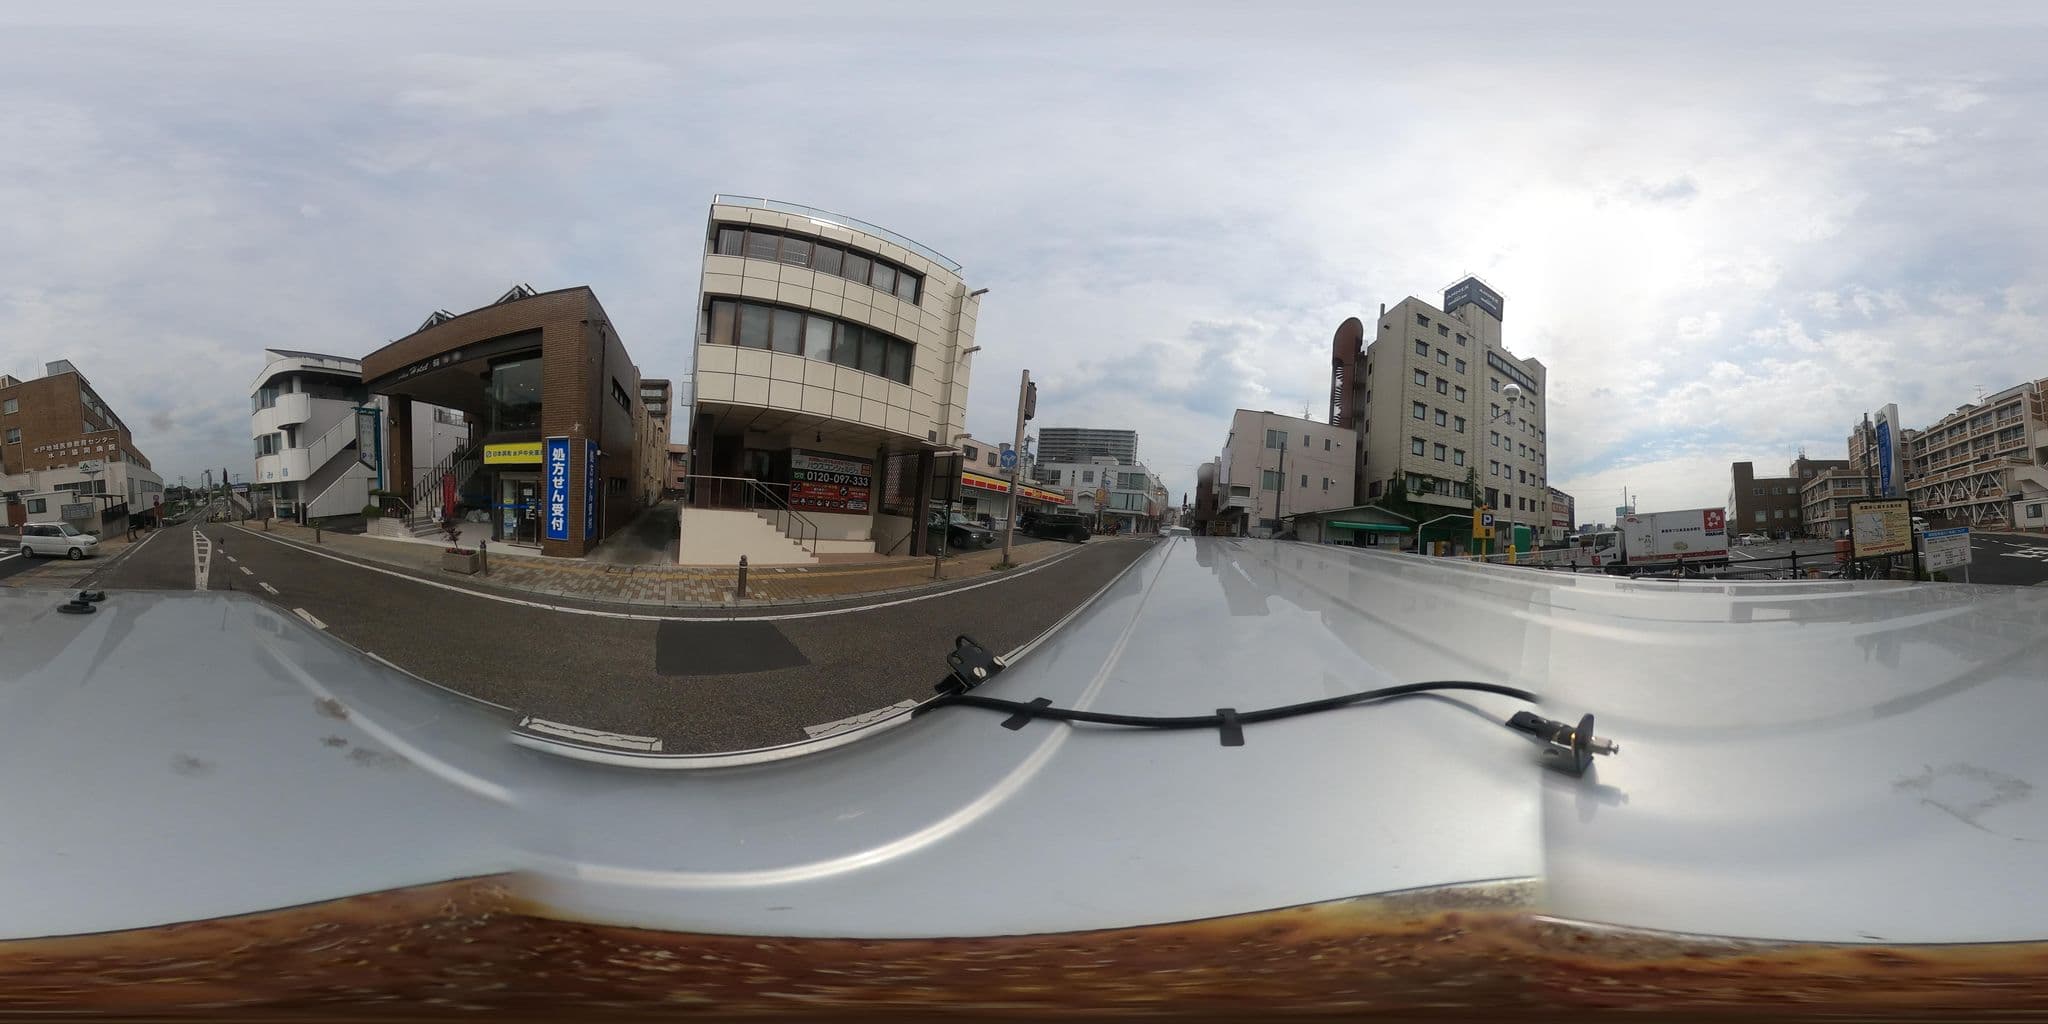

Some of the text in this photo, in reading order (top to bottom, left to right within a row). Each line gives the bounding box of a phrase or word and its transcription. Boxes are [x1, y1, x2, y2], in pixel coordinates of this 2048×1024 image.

[806, 471, 869, 487] 0120-097-333
[551, 447, 566, 531] 処方せん受付
[1483, 514, 1492, 526] P
